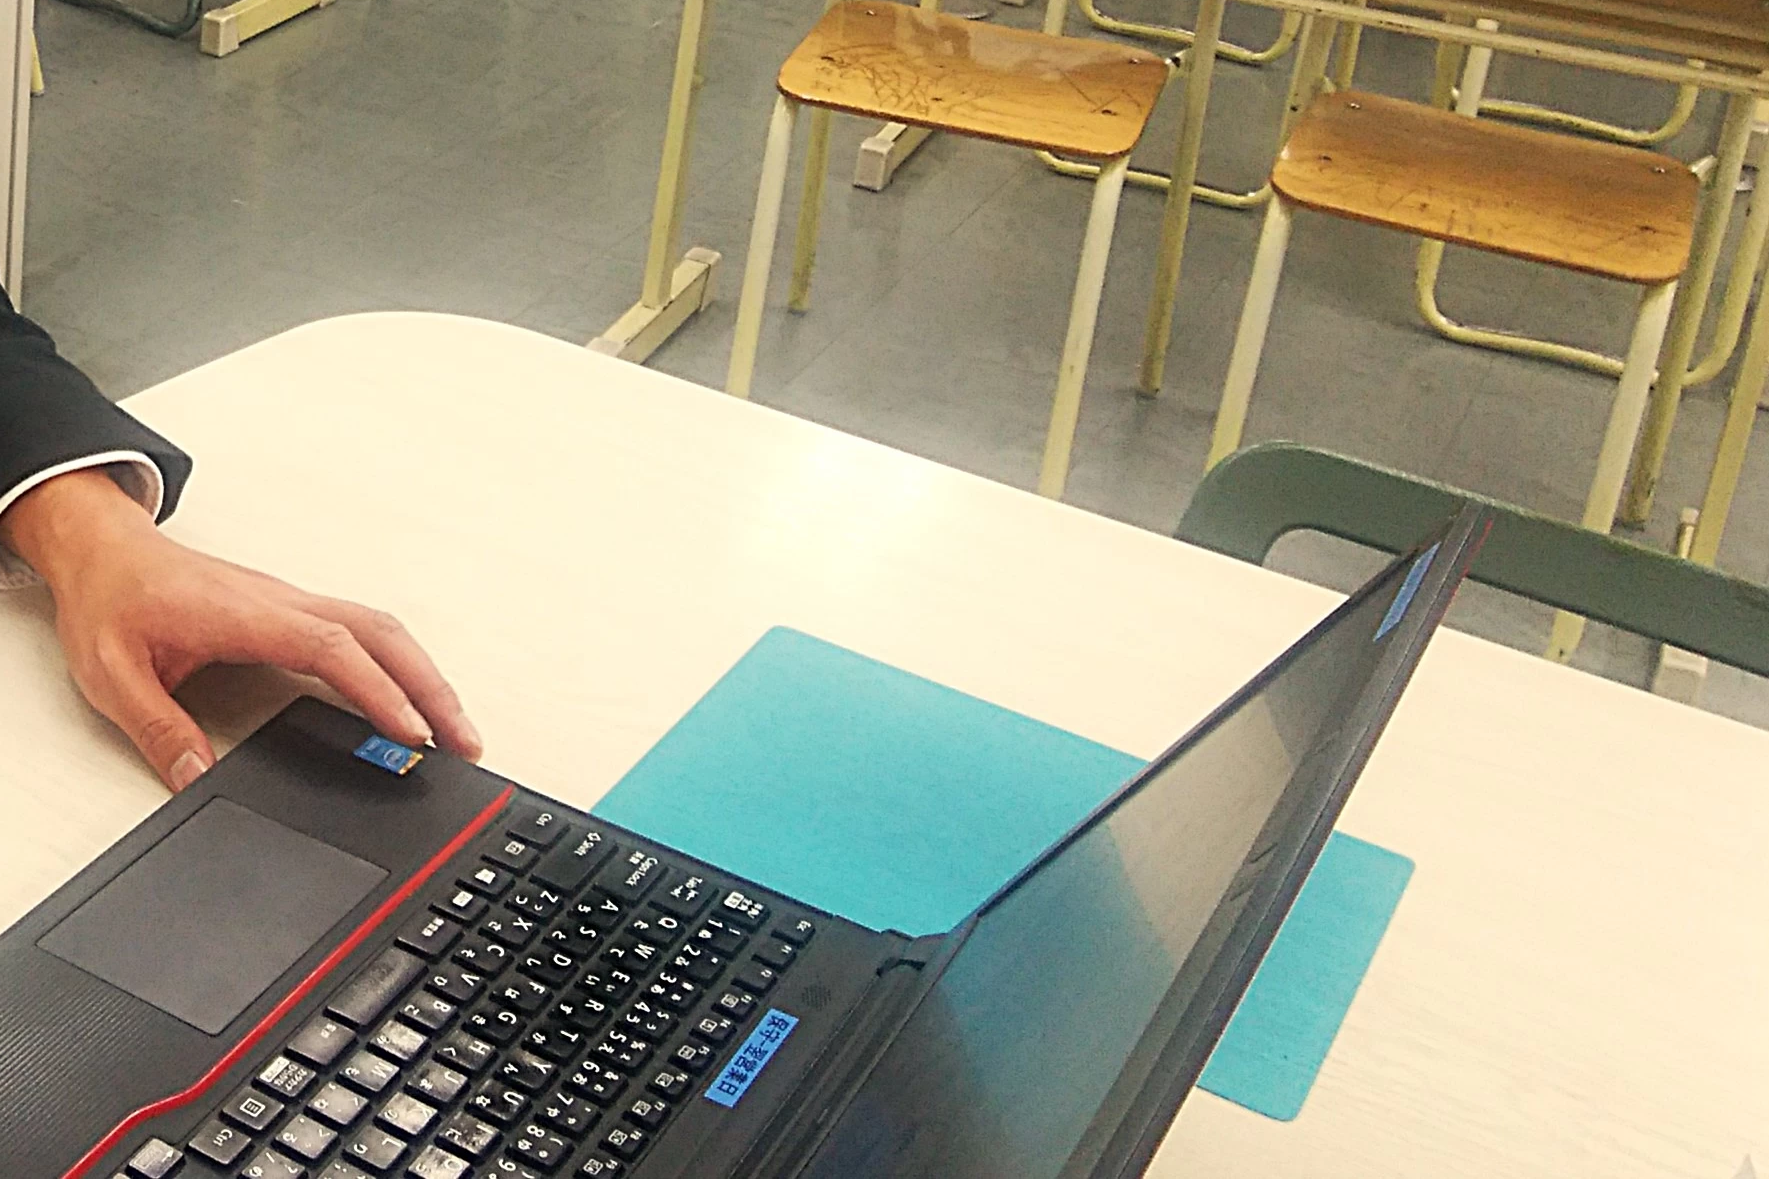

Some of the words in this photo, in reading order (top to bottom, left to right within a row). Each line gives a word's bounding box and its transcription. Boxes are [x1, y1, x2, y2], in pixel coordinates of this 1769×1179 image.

[574, 840, 594, 856] Shift
[515, 895, 528, 905] つ
[540, 890, 559, 903] Z
[577, 904, 592, 913] ち
[600, 899, 619, 912] A
[488, 921, 502, 931] さ
[512, 916, 533, 931] X
[633, 920, 649, 930] た
[658, 917, 678, 929] Q
[707, 919, 723, 928] 1
[551, 930, 566, 940] と
[579, 926, 597, 938] S
[460, 949, 476, 958] そ
[486, 944, 505, 957] C
[609, 948, 625, 958] て
[634, 944, 655, 959] W
[683, 944, 701, 956] 2
[526, 957, 542, 966] し
[553, 953, 572, 967] D
[433, 976, 448, 986] ひ
[461, 973, 480, 987] V
[585, 974, 600, 986] い
[611, 970, 631, 983] E
[659, 972, 677, 984] 3
[504, 987, 520, 999] は
[529, 981, 546, 994] F
[432, 1000, 452, 1013] B
[559, 1003, 573, 1015] す
[585, 999, 605, 1012] R
[634, 1001, 651, 1013] 4
[404, 1007, 420, 1018] こ
[498, 1011, 517, 1025] G
[626, 1013, 641, 1024] う
[471, 1014, 486, 1025] き
[560, 1030, 579, 1042] T
[609, 1030, 627, 1043] 5
[468, 1040, 491, 1055] H
[598, 1042, 615, 1054] え
[371, 1060, 393, 1077] M
[503, 1062, 519, 1074] ん
[531, 1059, 552, 1074] Y
[582, 1060, 600, 1073] 6
[345, 1067, 361, 1081] も
[444, 1070, 464, 1085] J
[572, 1073, 588, 1085] お
[503, 1091, 524, 1106] U
[556, 1092, 574, 1105] 7
[546, 1107, 560, 1118] や
[213, 1128, 233, 1147] Ctrl
[445, 1128, 462, 1143] に
[526, 1125, 545, 1138] 8
[353, 1143, 368, 1155] り
[382, 1138, 402, 1153] L
[517, 1139, 533, 1150] ゆ
[498, 1158, 516, 1172] 9
